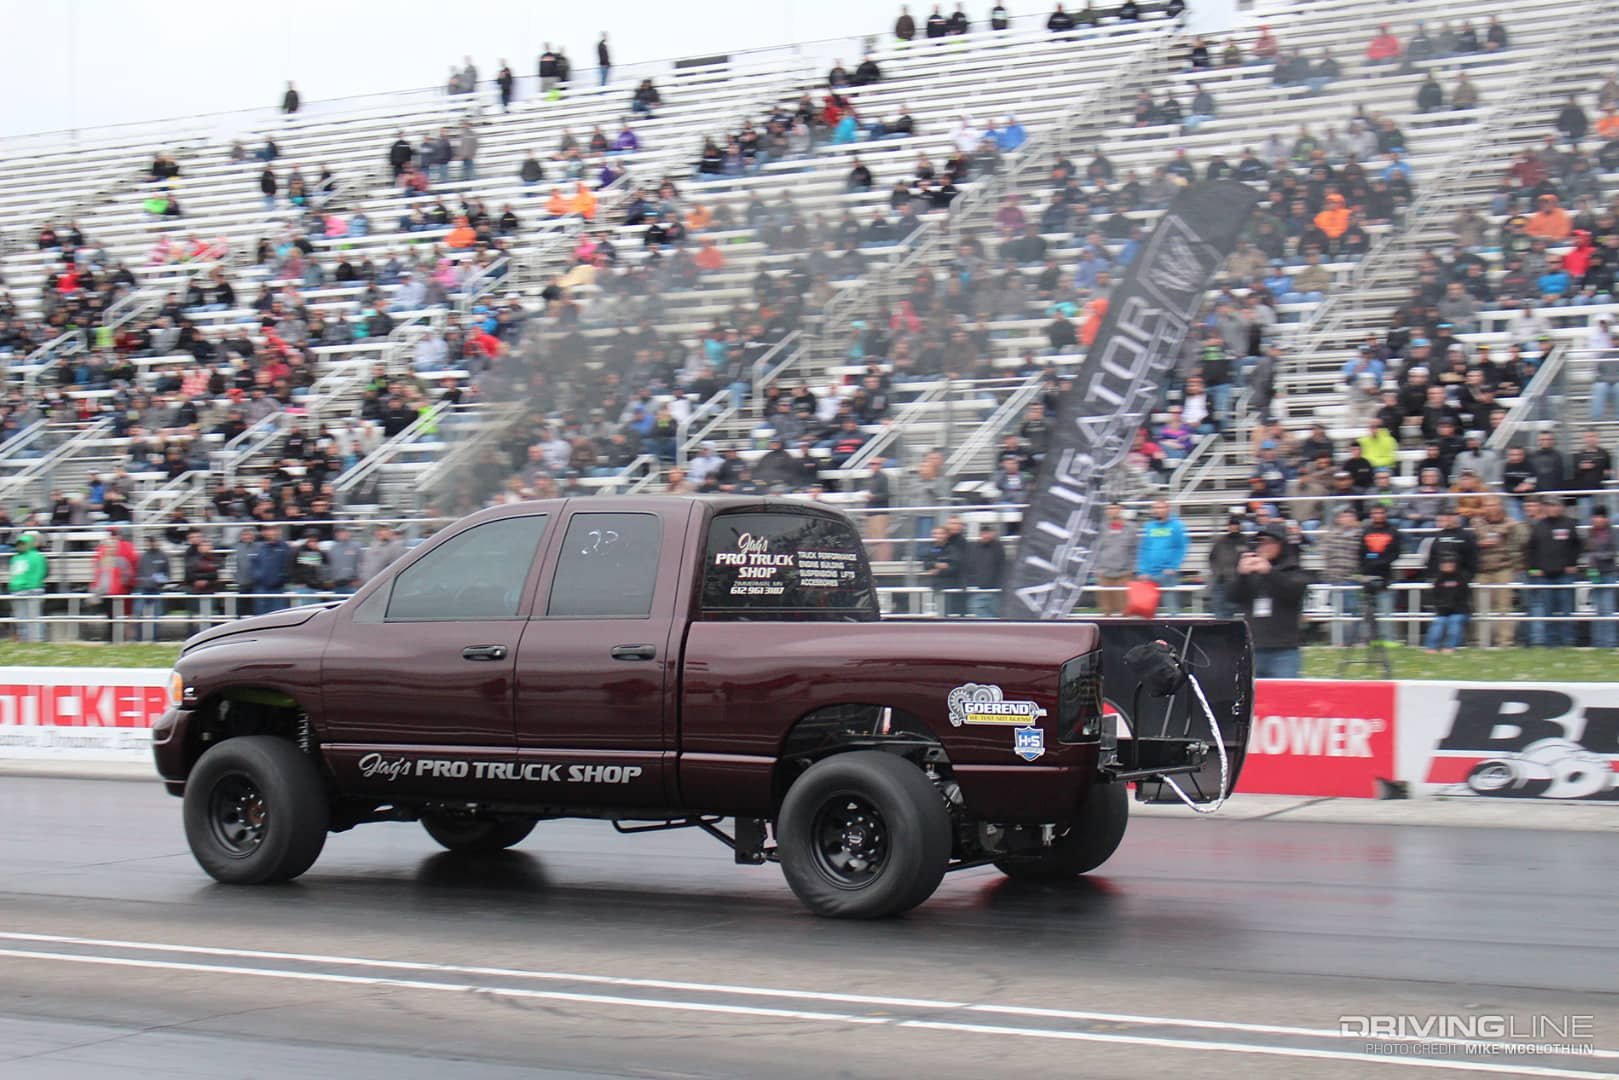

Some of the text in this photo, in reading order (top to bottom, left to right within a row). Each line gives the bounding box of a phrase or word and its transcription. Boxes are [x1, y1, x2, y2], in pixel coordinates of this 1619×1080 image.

[1015, 295, 1163, 613] ALLIGATOR
[715, 553, 794, 566] PRO TRUCK
[738, 567, 777, 578] SHOP
[0, 684, 168, 728] TICKER
[964, 702, 1029, 715] GOEREND
[415, 760, 468, 778] PRO
[472, 761, 562, 782] TRUCK
[567, 765, 642, 784] SHOP
